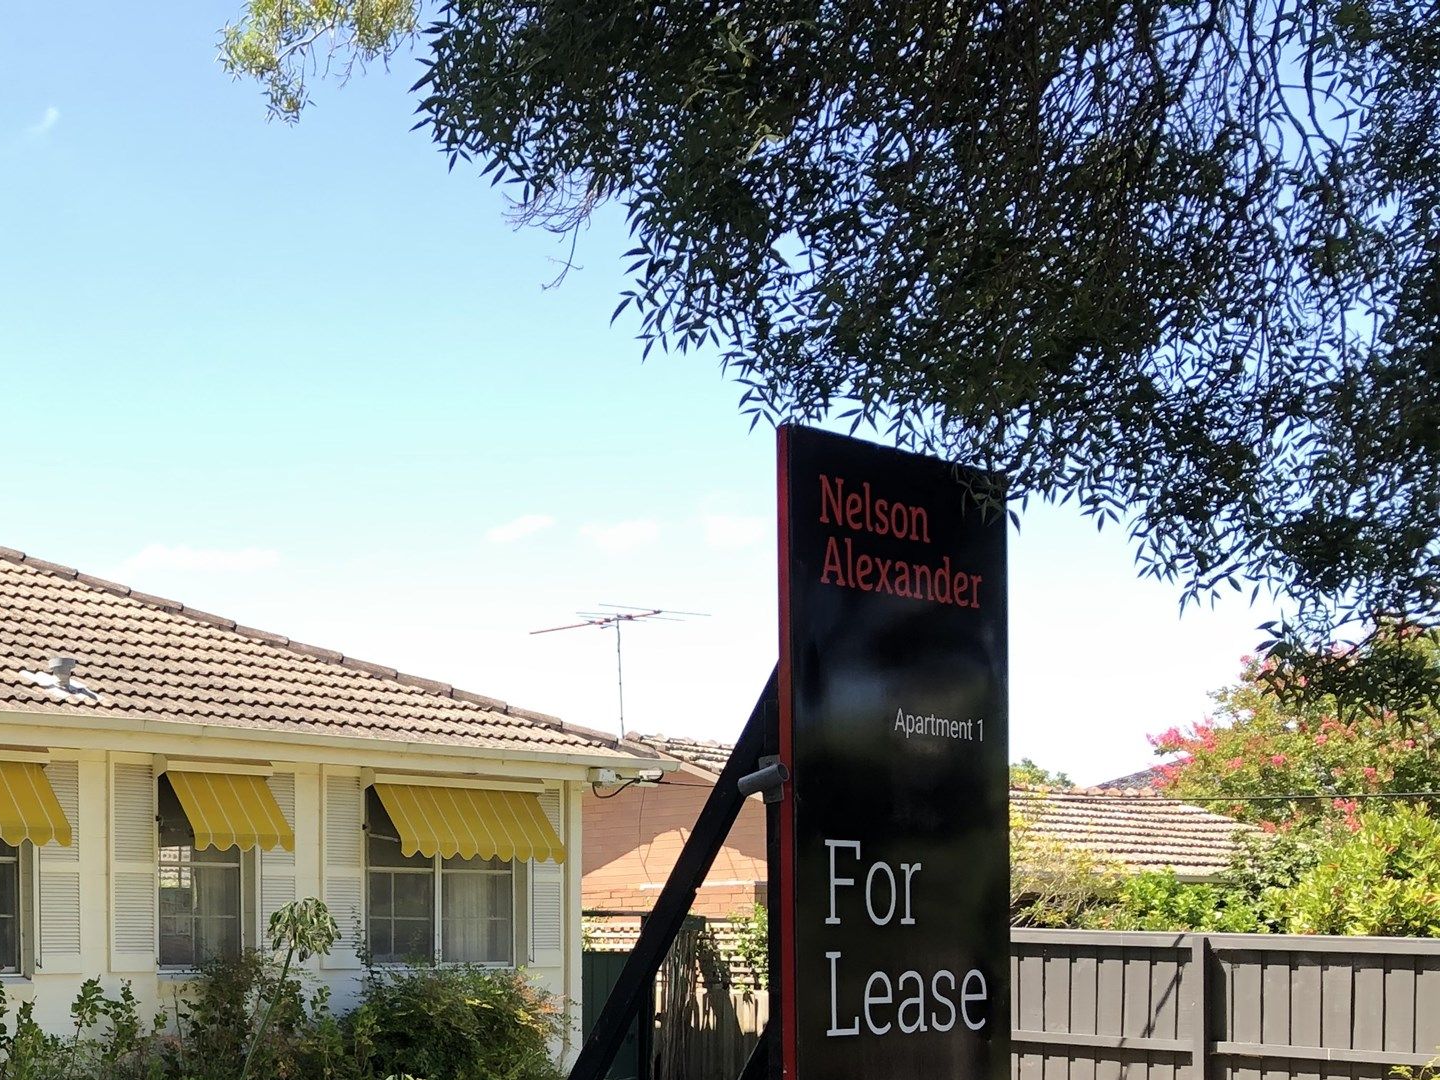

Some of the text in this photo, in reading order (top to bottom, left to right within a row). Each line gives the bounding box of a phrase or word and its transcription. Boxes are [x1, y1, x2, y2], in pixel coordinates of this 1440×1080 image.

[819, 474, 931, 543] Nelson
[820, 536, 983, 609] Alexander
[894, 707, 985, 742] Apartment 1
[824, 839, 922, 926] For
[825, 951, 988, 1037] Lease
